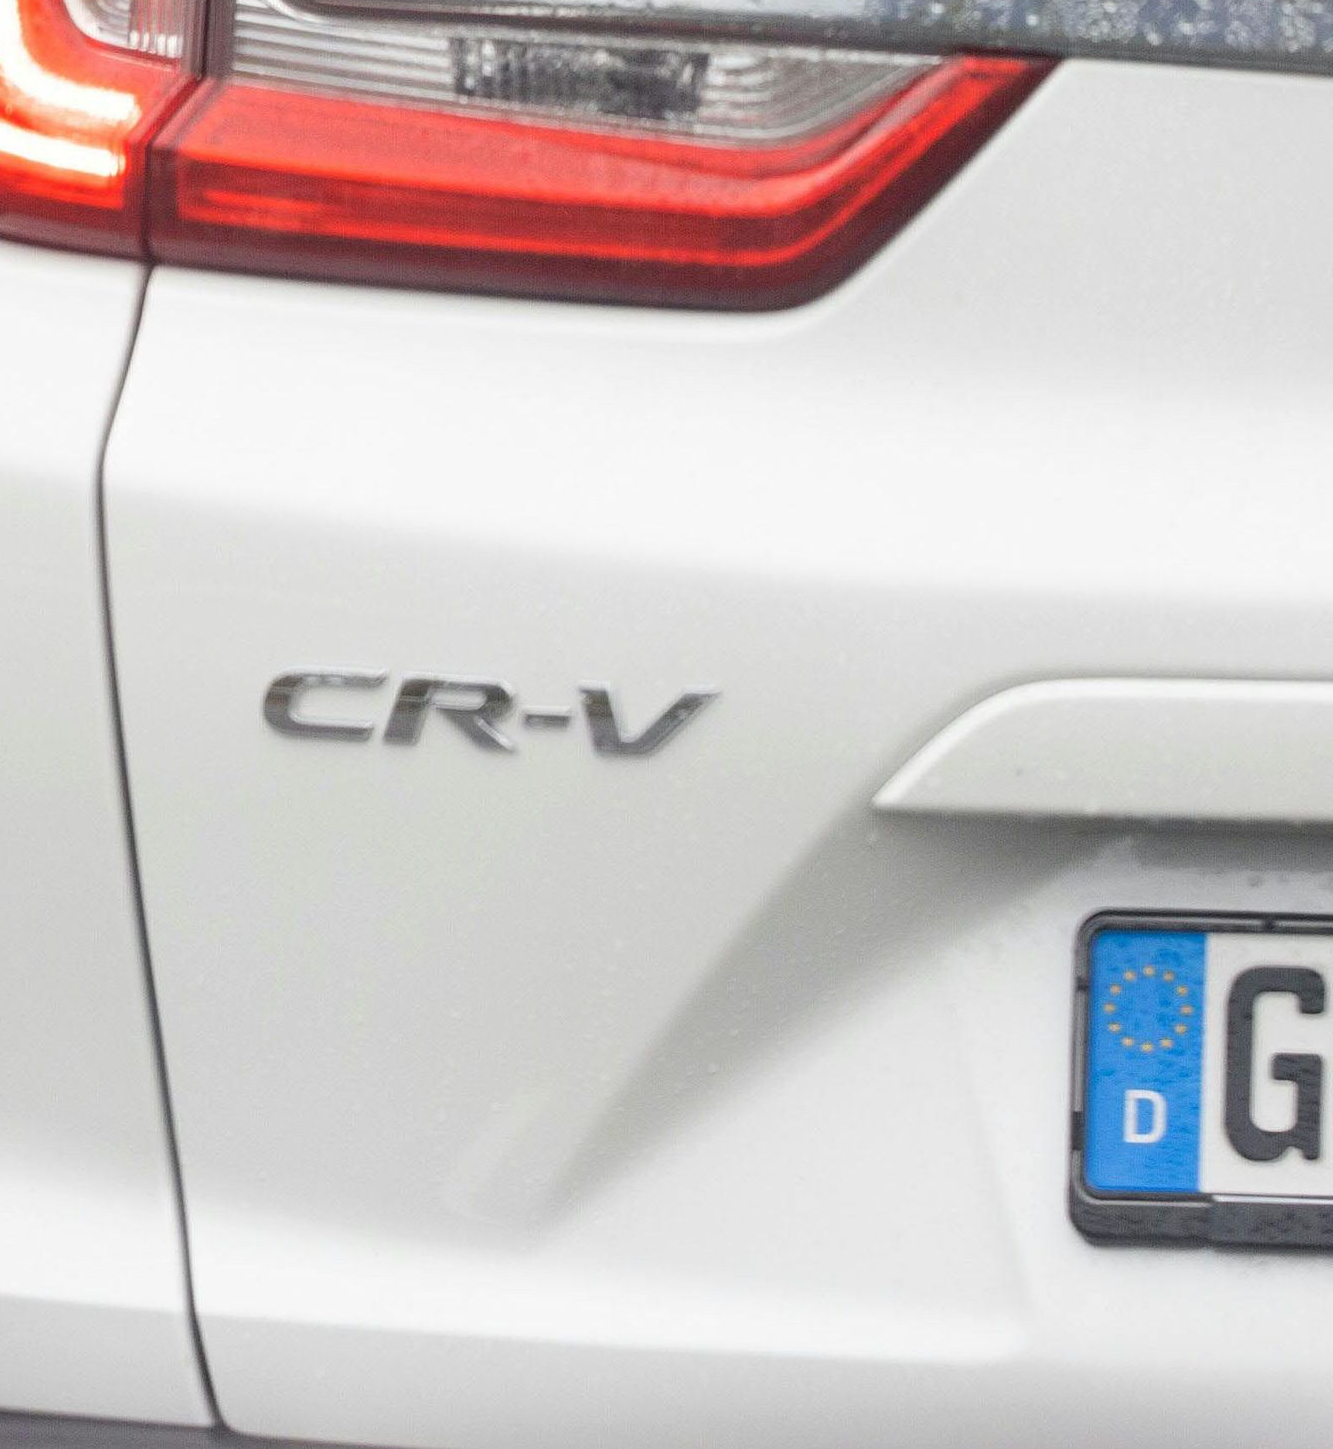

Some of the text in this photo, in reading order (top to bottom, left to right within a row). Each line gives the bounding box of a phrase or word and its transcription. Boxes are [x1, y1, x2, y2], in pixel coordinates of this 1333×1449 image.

[262, 666, 721, 756] CR-V
[1225, 966, 1326, 1162] G
[1122, 1089, 1168, 1144] D
